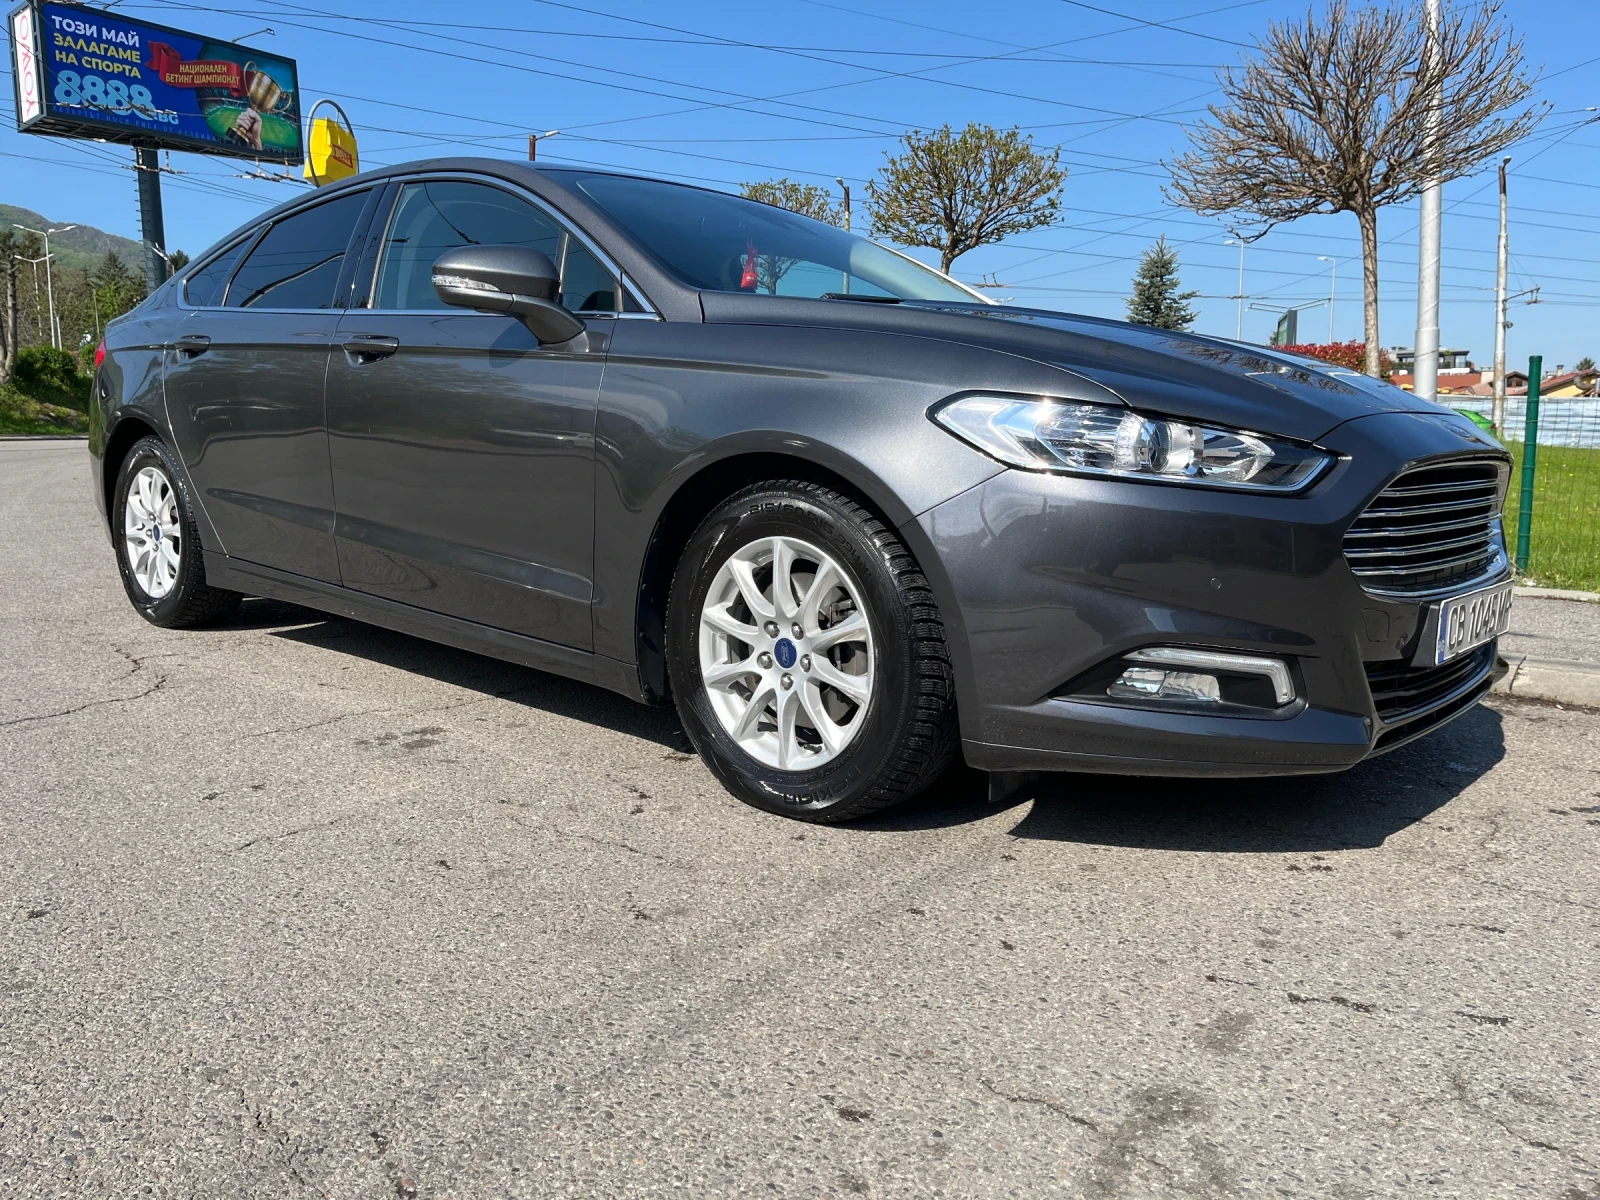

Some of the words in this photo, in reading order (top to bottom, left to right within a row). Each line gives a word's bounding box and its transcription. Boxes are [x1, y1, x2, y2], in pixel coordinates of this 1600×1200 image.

[51, 15, 98, 38] ТОЗИ
[101, 27, 140, 48] МАЙ
[53, 32, 141, 64] ЗАЛАГАМЕ
[55, 49, 79, 66] НА
[81, 61, 142, 79] СПОРТА
[165, 72, 193, 84] БЕТИНГ
[193, 73, 240, 85] ШАМПИОНАТ
[179, 63, 227, 75] НАЦИОНАЛЕН
[1448, 604, 1466, 650] CB
[1468, 593, 1498, 642] 1045
